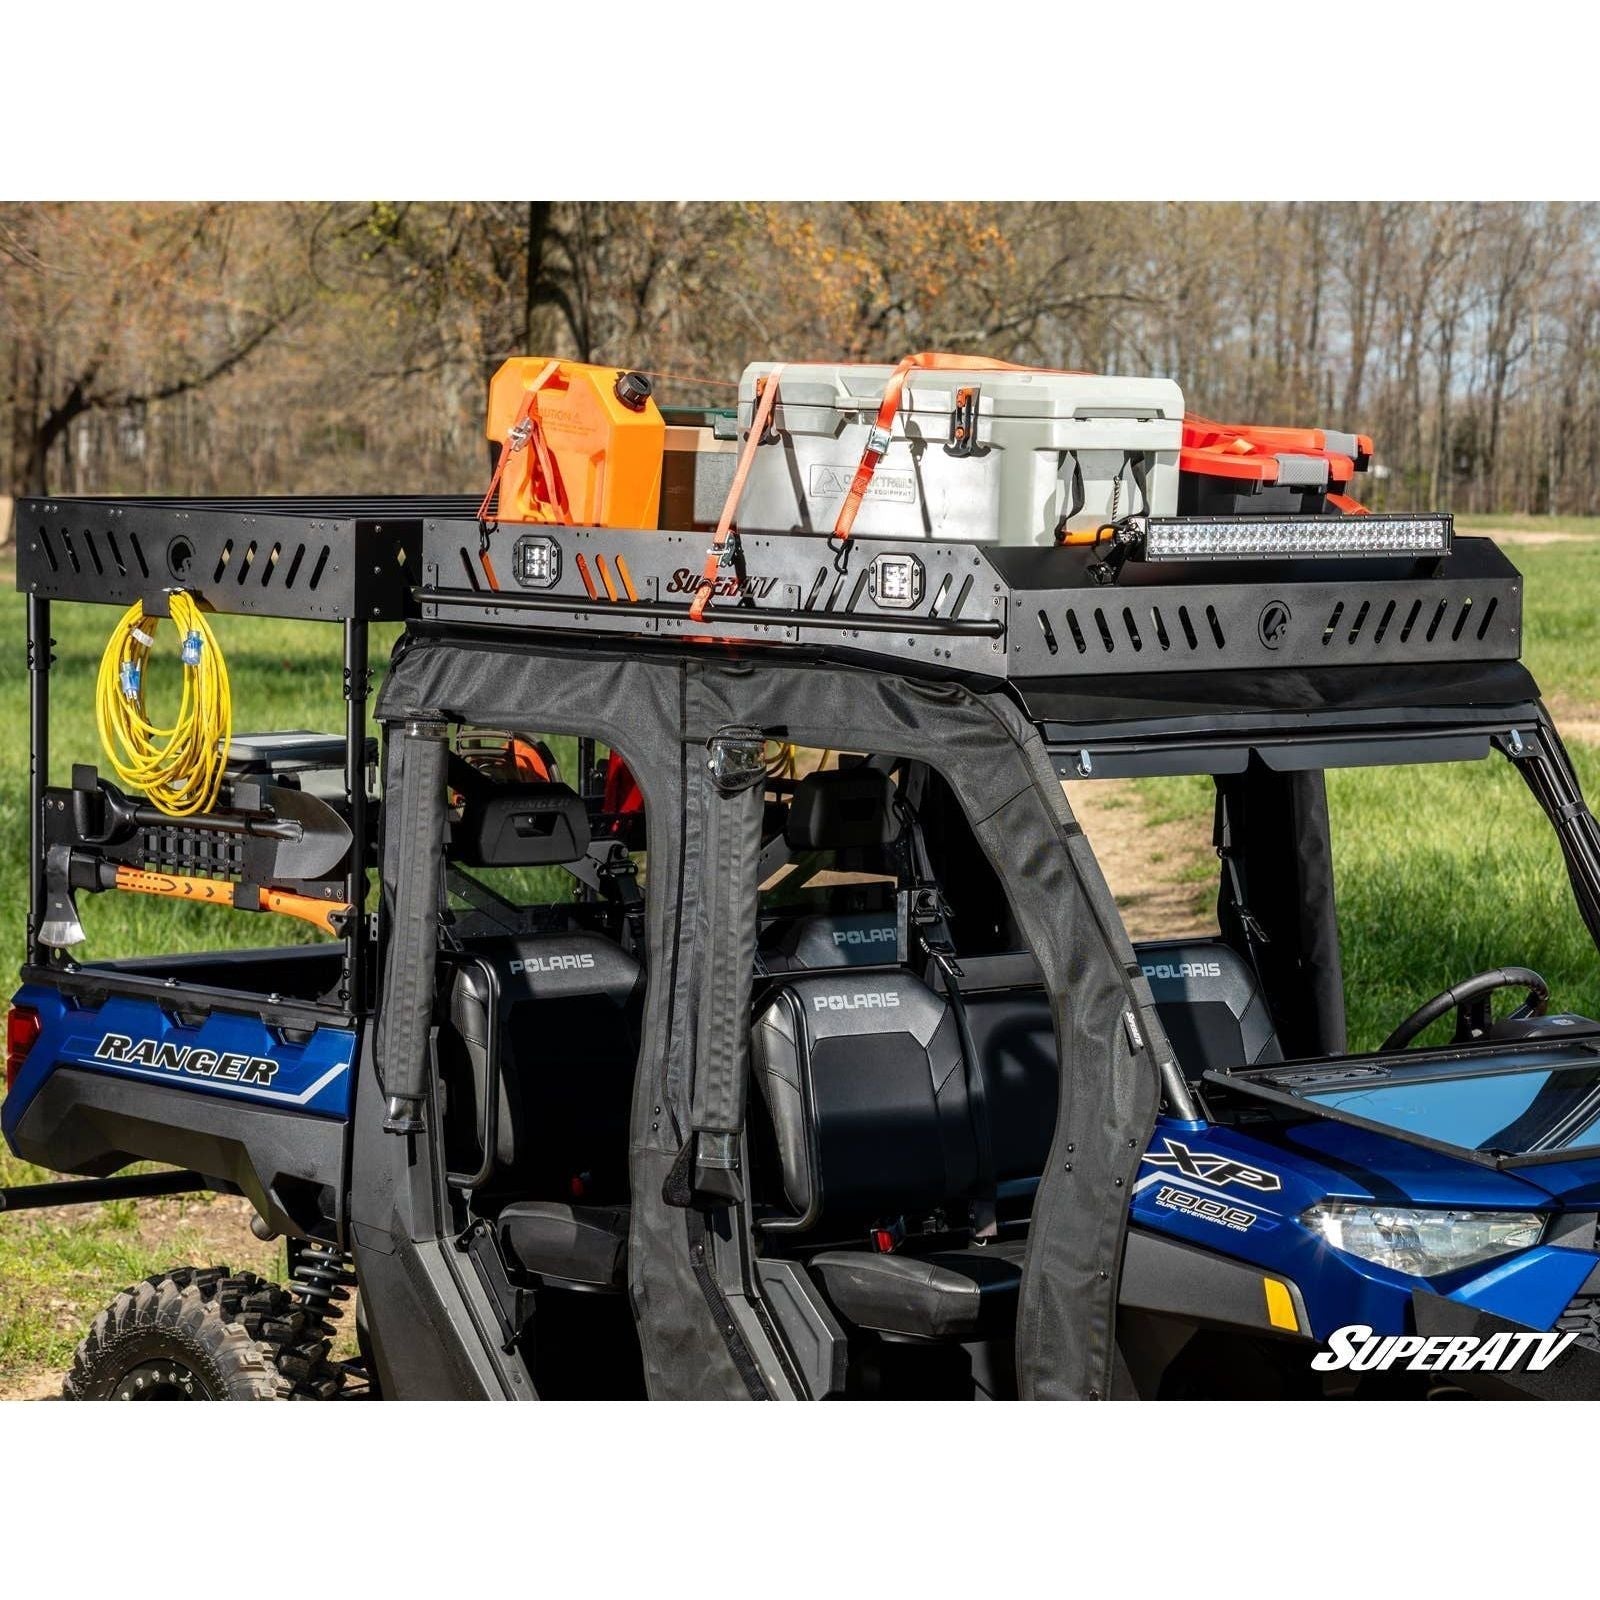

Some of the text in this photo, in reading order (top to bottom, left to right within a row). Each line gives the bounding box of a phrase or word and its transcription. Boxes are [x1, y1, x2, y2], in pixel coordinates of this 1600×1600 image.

[666, 567, 779, 599] SUERATV
[832, 927, 897, 945] POLAR
[509, 953, 595, 975] POLARIS
[1141, 962, 1221, 979] POLARIS
[813, 991, 900, 1012] POLARIS
[94, 1033, 279, 1086] RANGER
[1141, 1137, 1282, 1192] XP
[1155, 1200, 1248, 1232] DUAL OVERHEAD CAM
[1156, 1186, 1256, 1227] 1000
